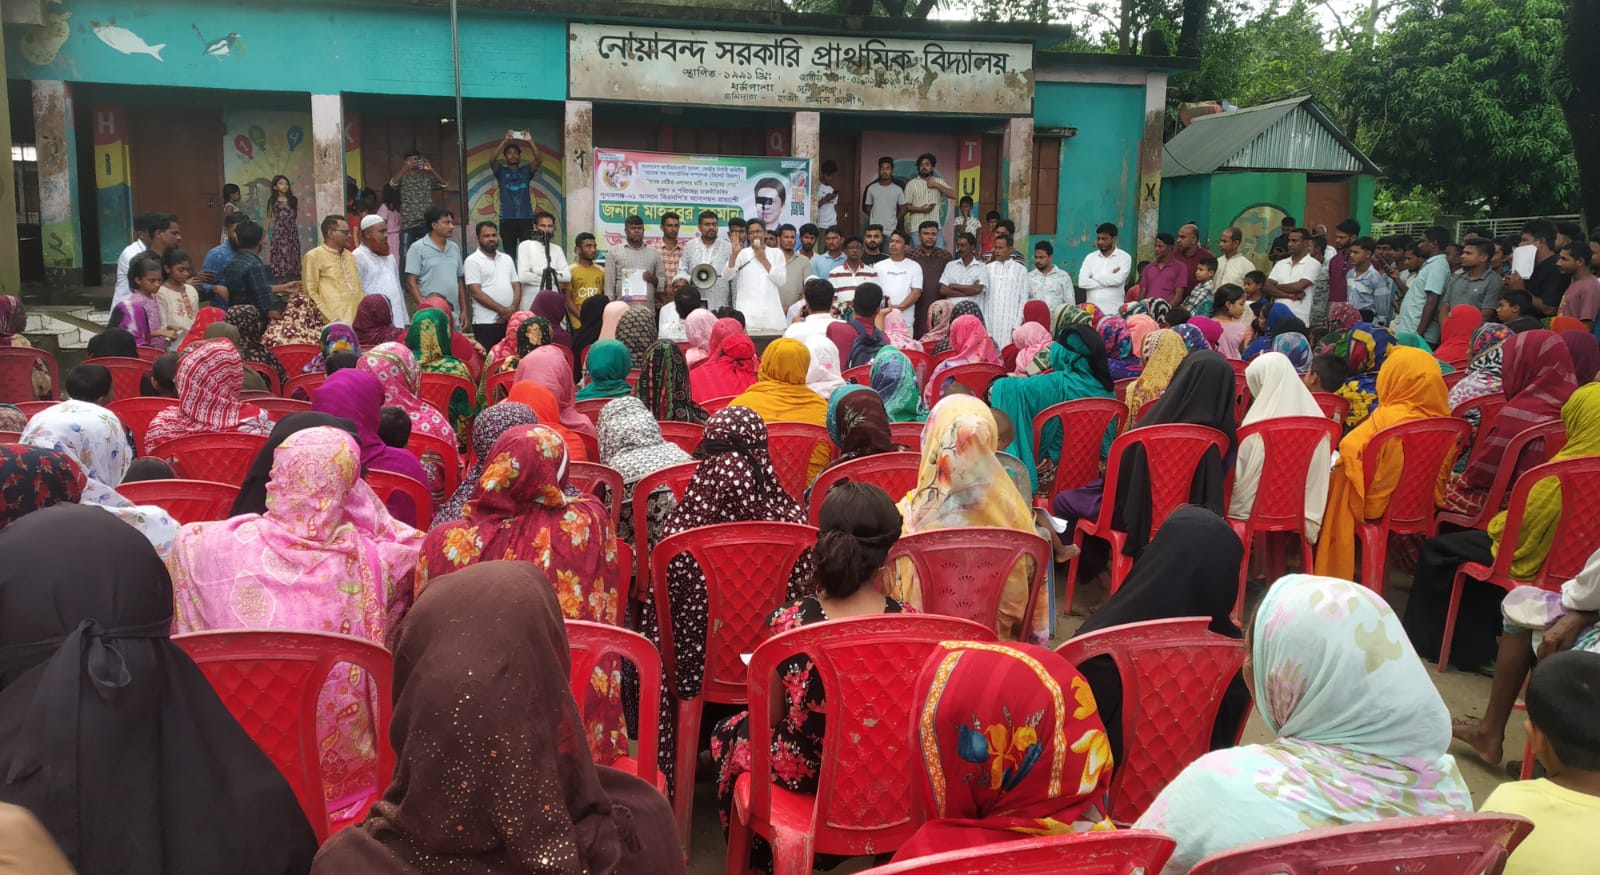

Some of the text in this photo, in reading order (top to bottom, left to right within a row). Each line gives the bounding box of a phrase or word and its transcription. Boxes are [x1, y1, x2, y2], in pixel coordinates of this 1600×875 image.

[599, 31, 1009, 75] নোয়াবন্দ সরকারি প্রাথমিক বিদ্যালয়
[682, 65, 717, 79] স্থাপিত
[723, 71, 753, 80] ১৯৯১
[730, 81, 775, 92] ধর্মপাশা
[97, 112, 115, 135] H
[770, 131, 784, 152] Q
[964, 141, 977, 161] T
[963, 177, 976, 196] U
[1145, 183, 1156, 201] X
[601, 202, 639, 219] জনাব
